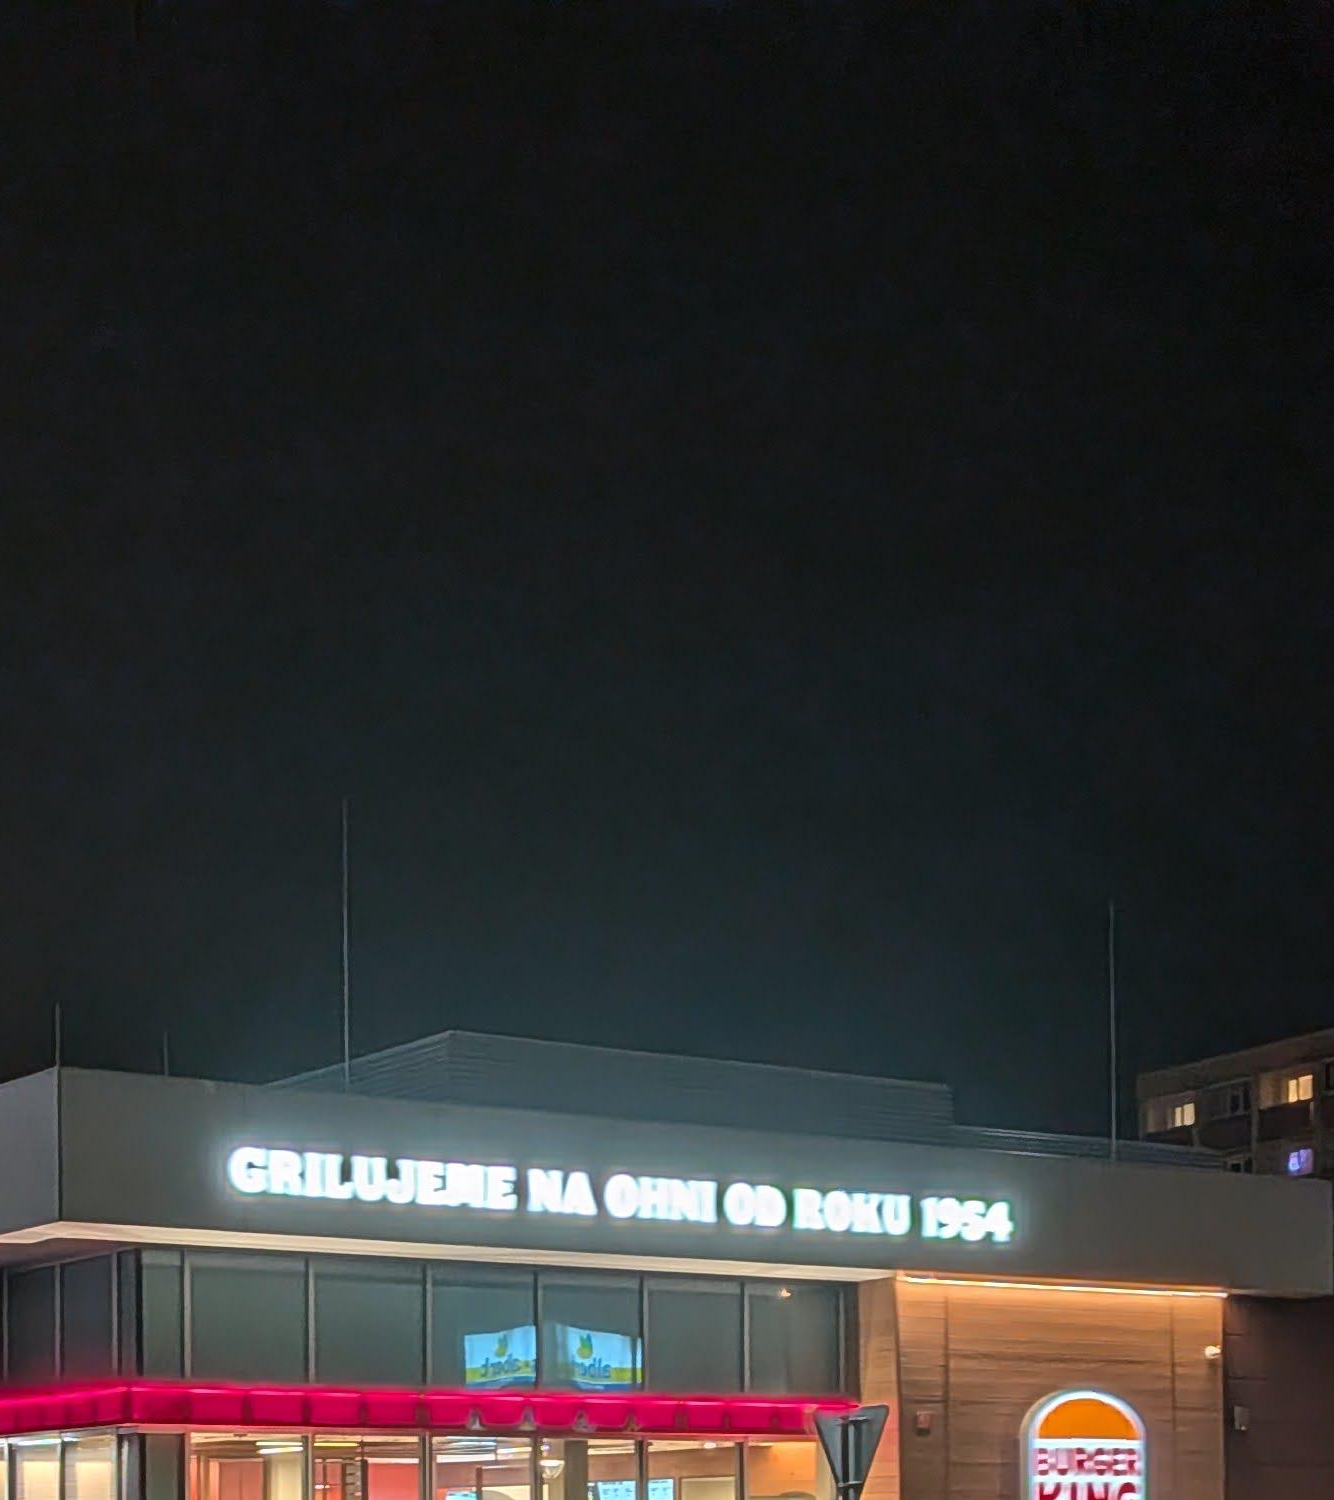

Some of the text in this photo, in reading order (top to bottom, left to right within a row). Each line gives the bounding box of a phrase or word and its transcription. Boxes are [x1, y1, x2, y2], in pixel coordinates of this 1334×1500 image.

[228, 1146, 1014, 1242] GRILUJEME NA OHNI OD ROKU 1954
[1036, 1448, 1140, 1476] BURGER
